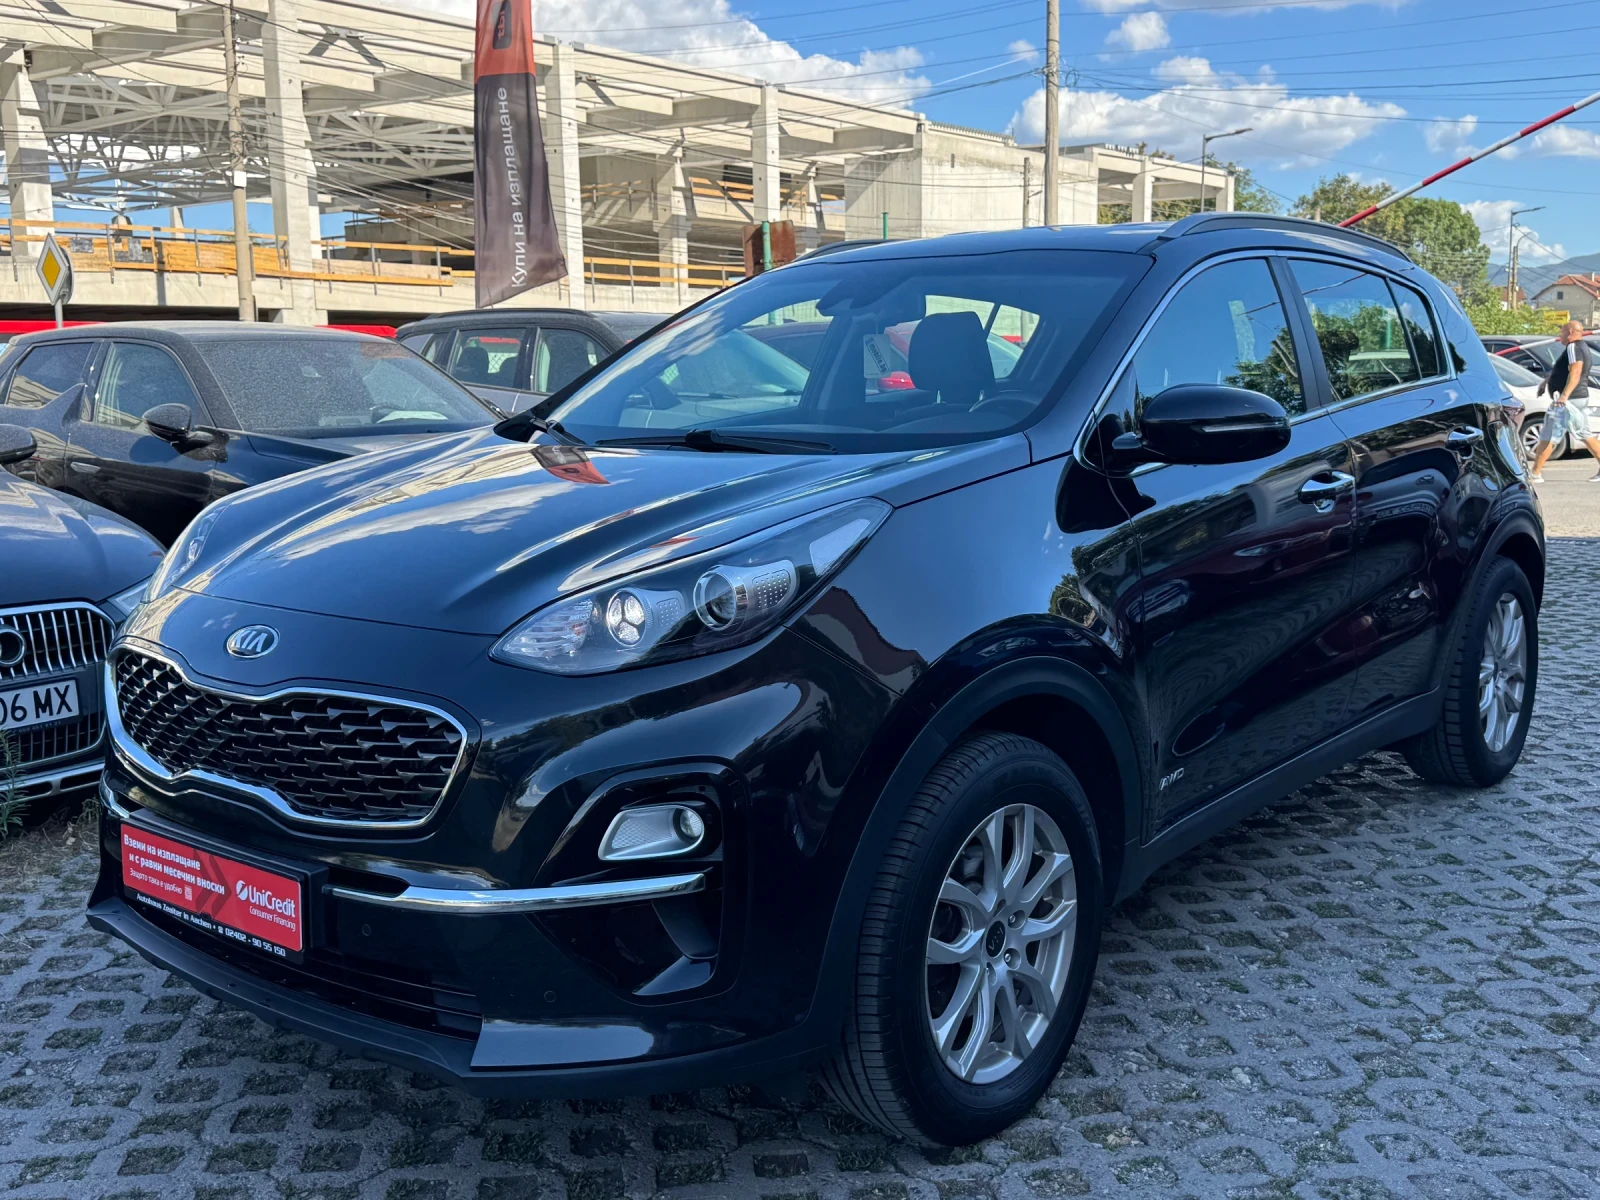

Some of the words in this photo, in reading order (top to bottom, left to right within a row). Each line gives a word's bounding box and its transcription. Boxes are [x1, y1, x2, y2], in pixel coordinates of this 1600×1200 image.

[498, 87, 521, 207] изплащане
[512, 212, 525, 235] на
[512, 242, 526, 287] Купи
[33, 684, 73, 719] MX
[1159, 768, 1184, 790] AWD
[124, 834, 146, 852] Вземи
[147, 844, 156, 855] на
[158, 848, 200, 871] изплащане
[129, 853, 134, 862] и
[135, 856, 140, 864] с
[141, 858, 162, 872] равни
[164, 866, 195, 884] месечни
[197, 878, 225, 895] вноски
[130, 868, 148, 882] Защото
[149, 876, 160, 886] така
[164, 882, 183, 895] удобно
[249, 885, 296, 918] UniCredit
[250, 906, 273, 922] Consumer
[274, 915, 296, 932] Financing
[137, 893, 162, 909] Autohaus
[190, 915, 212, 930] Aachen
[225, 928, 247, 943] 02402
[252, 938, 262, 948] 90
[263, 942, 273, 952] 55
[274, 946, 286, 957] 150
